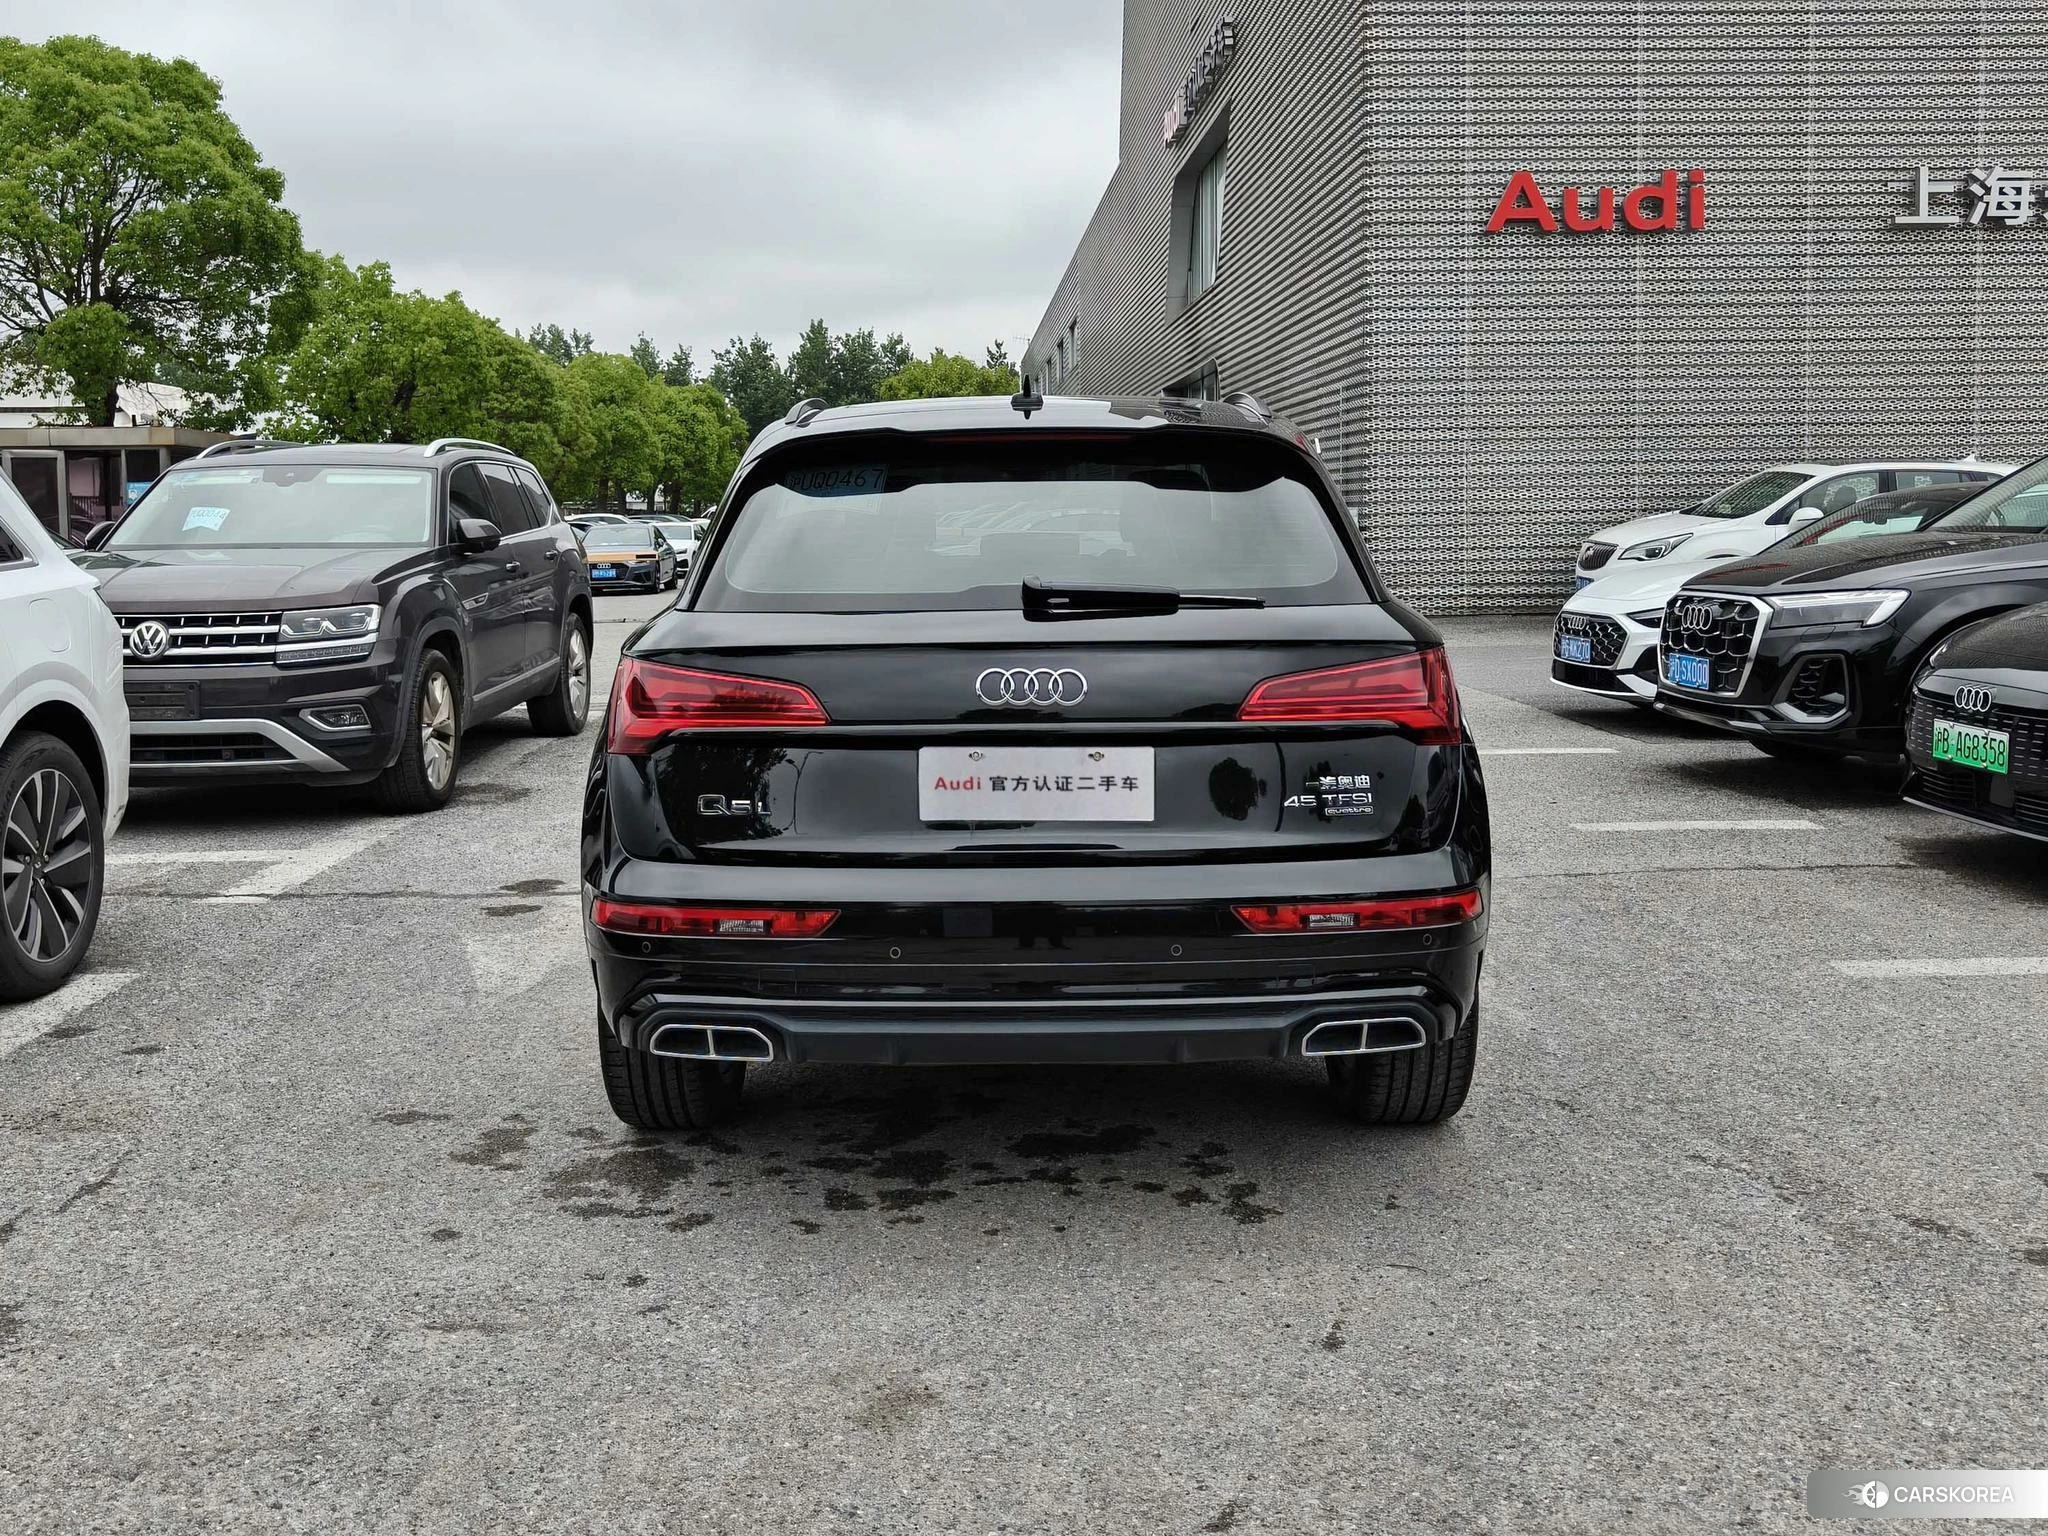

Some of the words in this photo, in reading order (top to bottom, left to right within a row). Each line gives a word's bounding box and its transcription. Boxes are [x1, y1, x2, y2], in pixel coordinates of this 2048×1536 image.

[1486, 168, 1705, 232] Audi
[1892, 165, 2048, 226] 上海
[935, 775, 982, 790] Audi
[989, 775, 1139, 792] 官方认证二手车
[697, 794, 771, 815] Q5L
[1284, 795, 1317, 807] 45
[1322, 793, 1372, 805] TFSI
[1327, 807, 1372, 815] quattro
